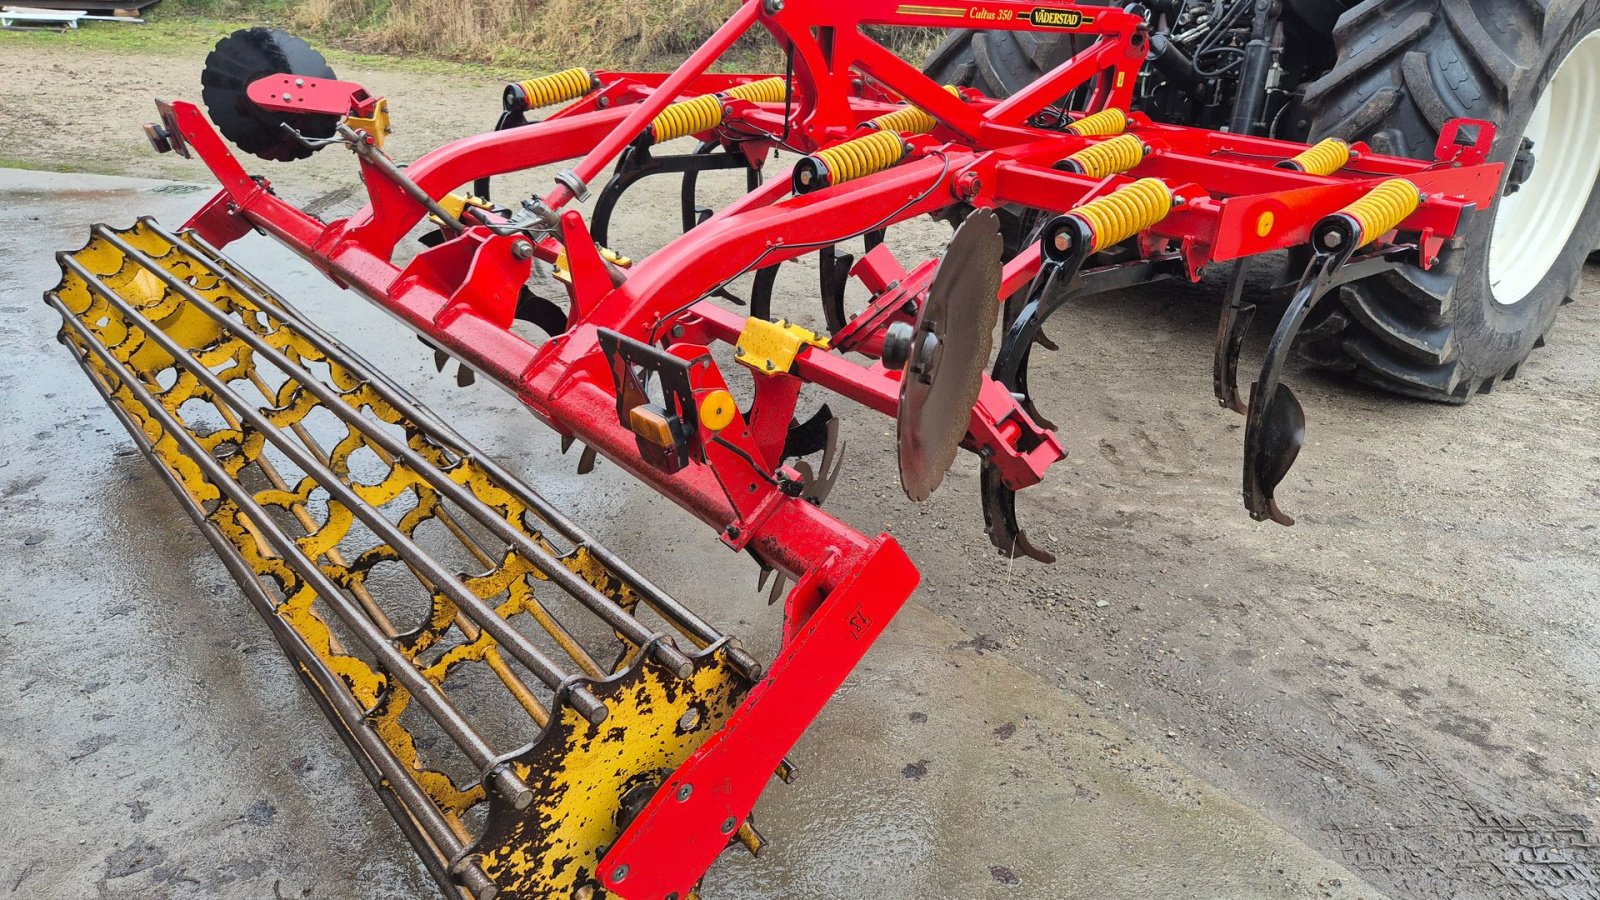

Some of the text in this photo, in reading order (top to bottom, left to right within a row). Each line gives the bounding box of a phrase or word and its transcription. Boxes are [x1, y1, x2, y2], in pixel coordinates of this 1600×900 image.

[969, 6, 1013, 21] Cultus 350
[1034, 9, 1079, 25] VÄDERSTAD
